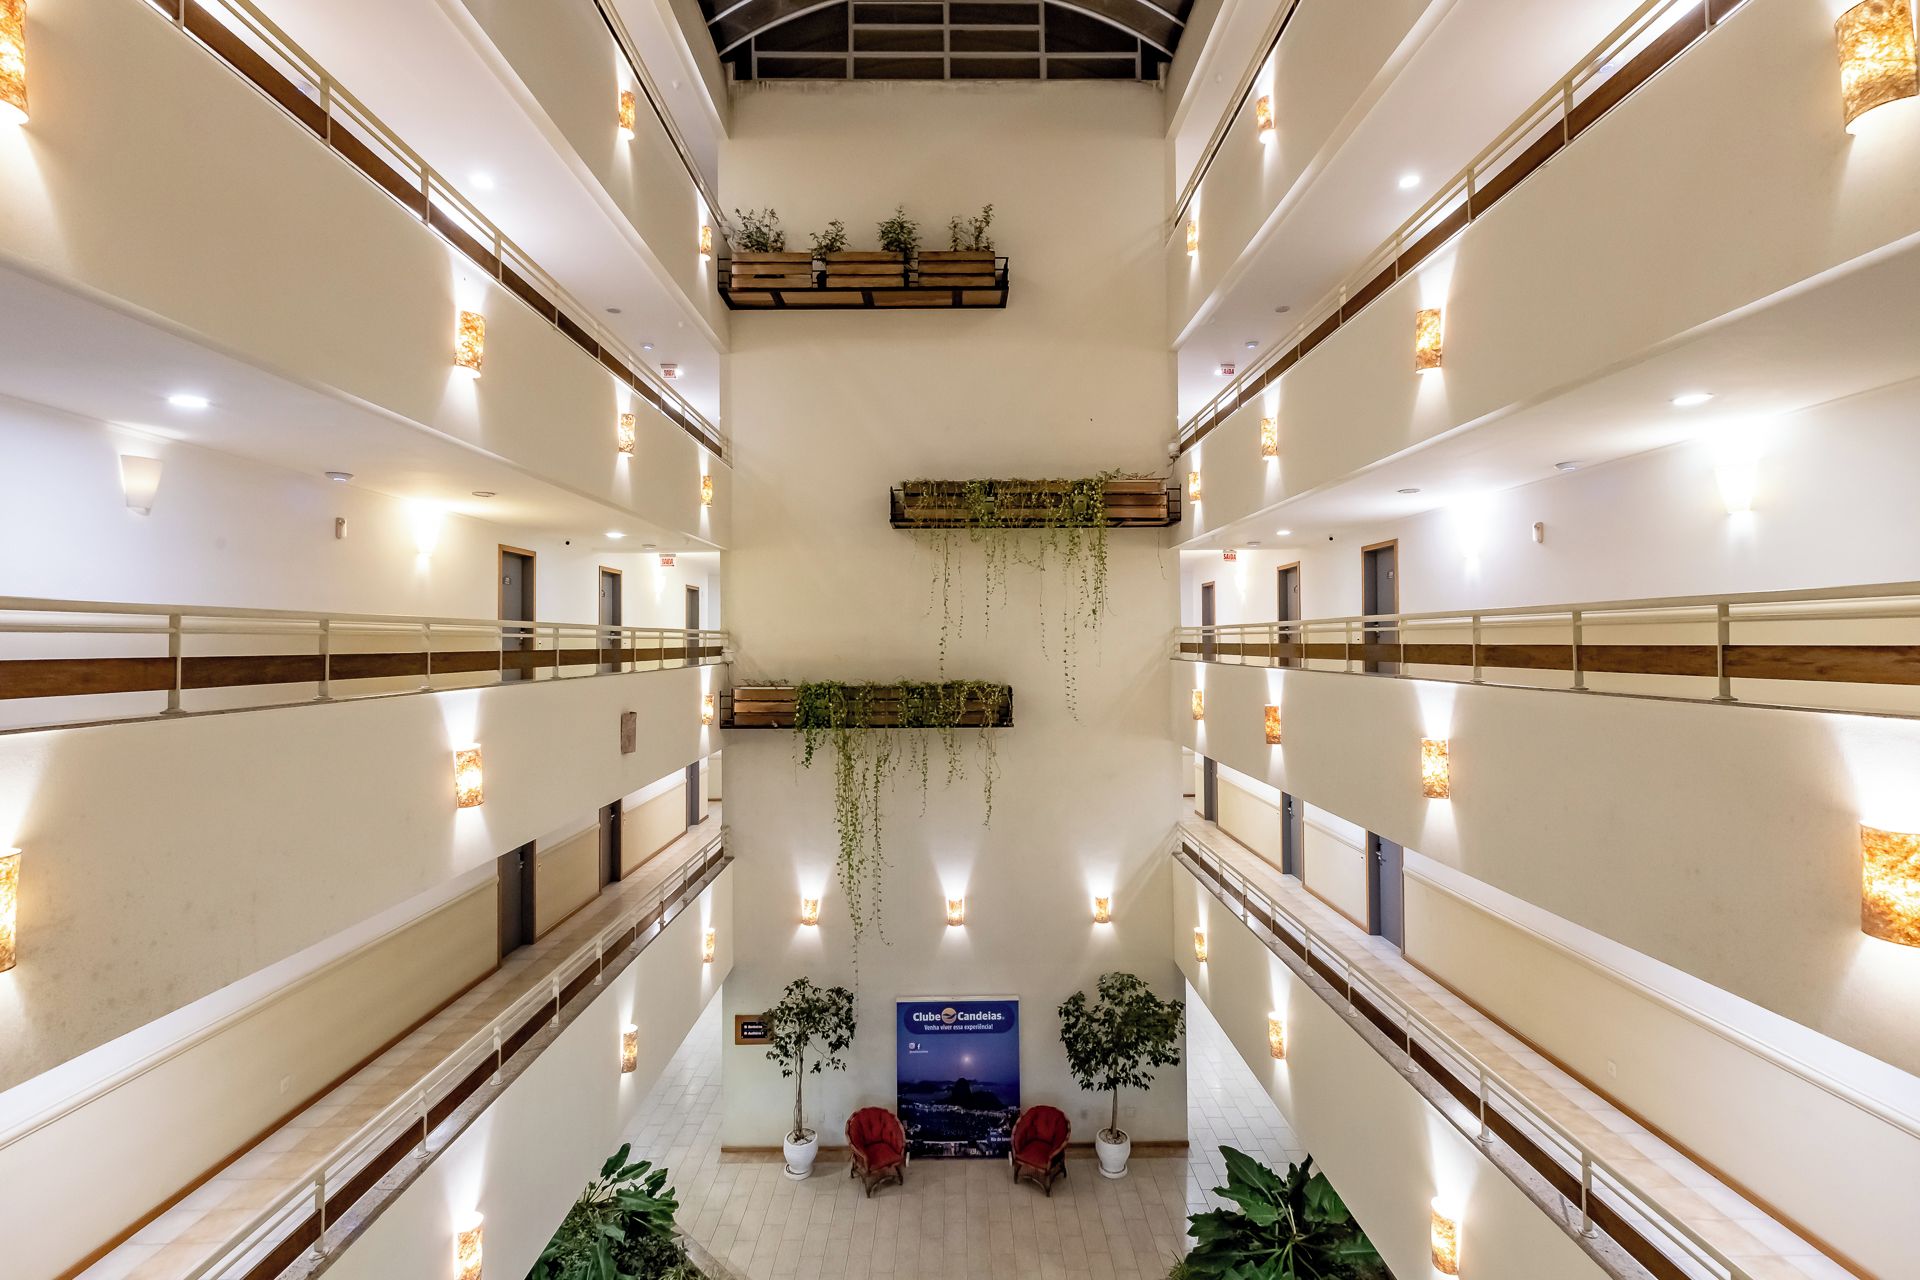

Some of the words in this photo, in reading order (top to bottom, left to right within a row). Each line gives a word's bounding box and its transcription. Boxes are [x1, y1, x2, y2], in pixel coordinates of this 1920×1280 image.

[913, 1012, 941, 1021] Clube
[958, 1011, 1002, 1021] Candeias
[964, 1023, 993, 1031] experiência!
